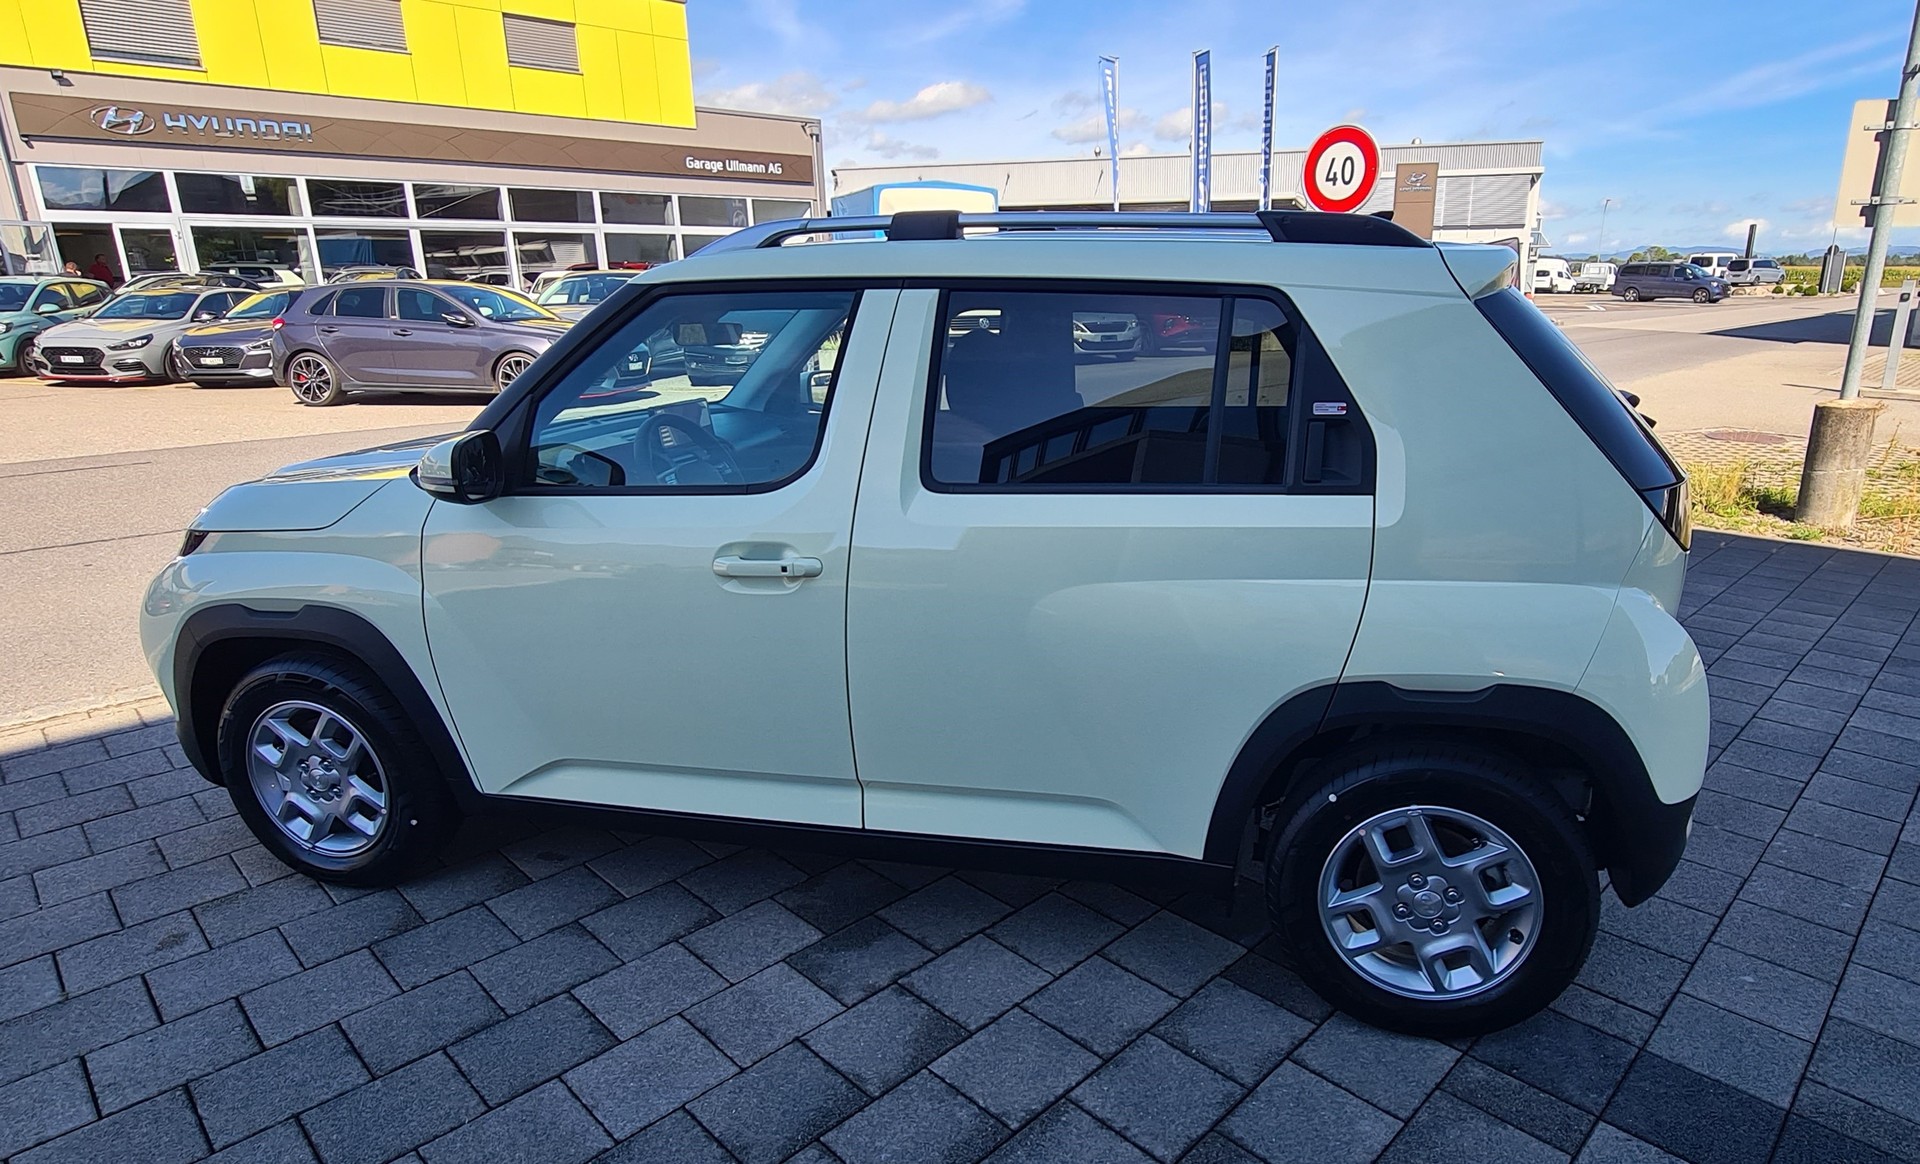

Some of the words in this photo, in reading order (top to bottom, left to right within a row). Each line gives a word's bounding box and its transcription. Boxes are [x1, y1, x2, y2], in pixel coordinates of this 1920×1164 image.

[162, 112, 314, 143] HYUNDAI
[685, 156, 724, 173] Garage
[725, 159, 766, 174] Ullmann
[767, 162, 783, 175] AG
[1325, 155, 1355, 187] 40
